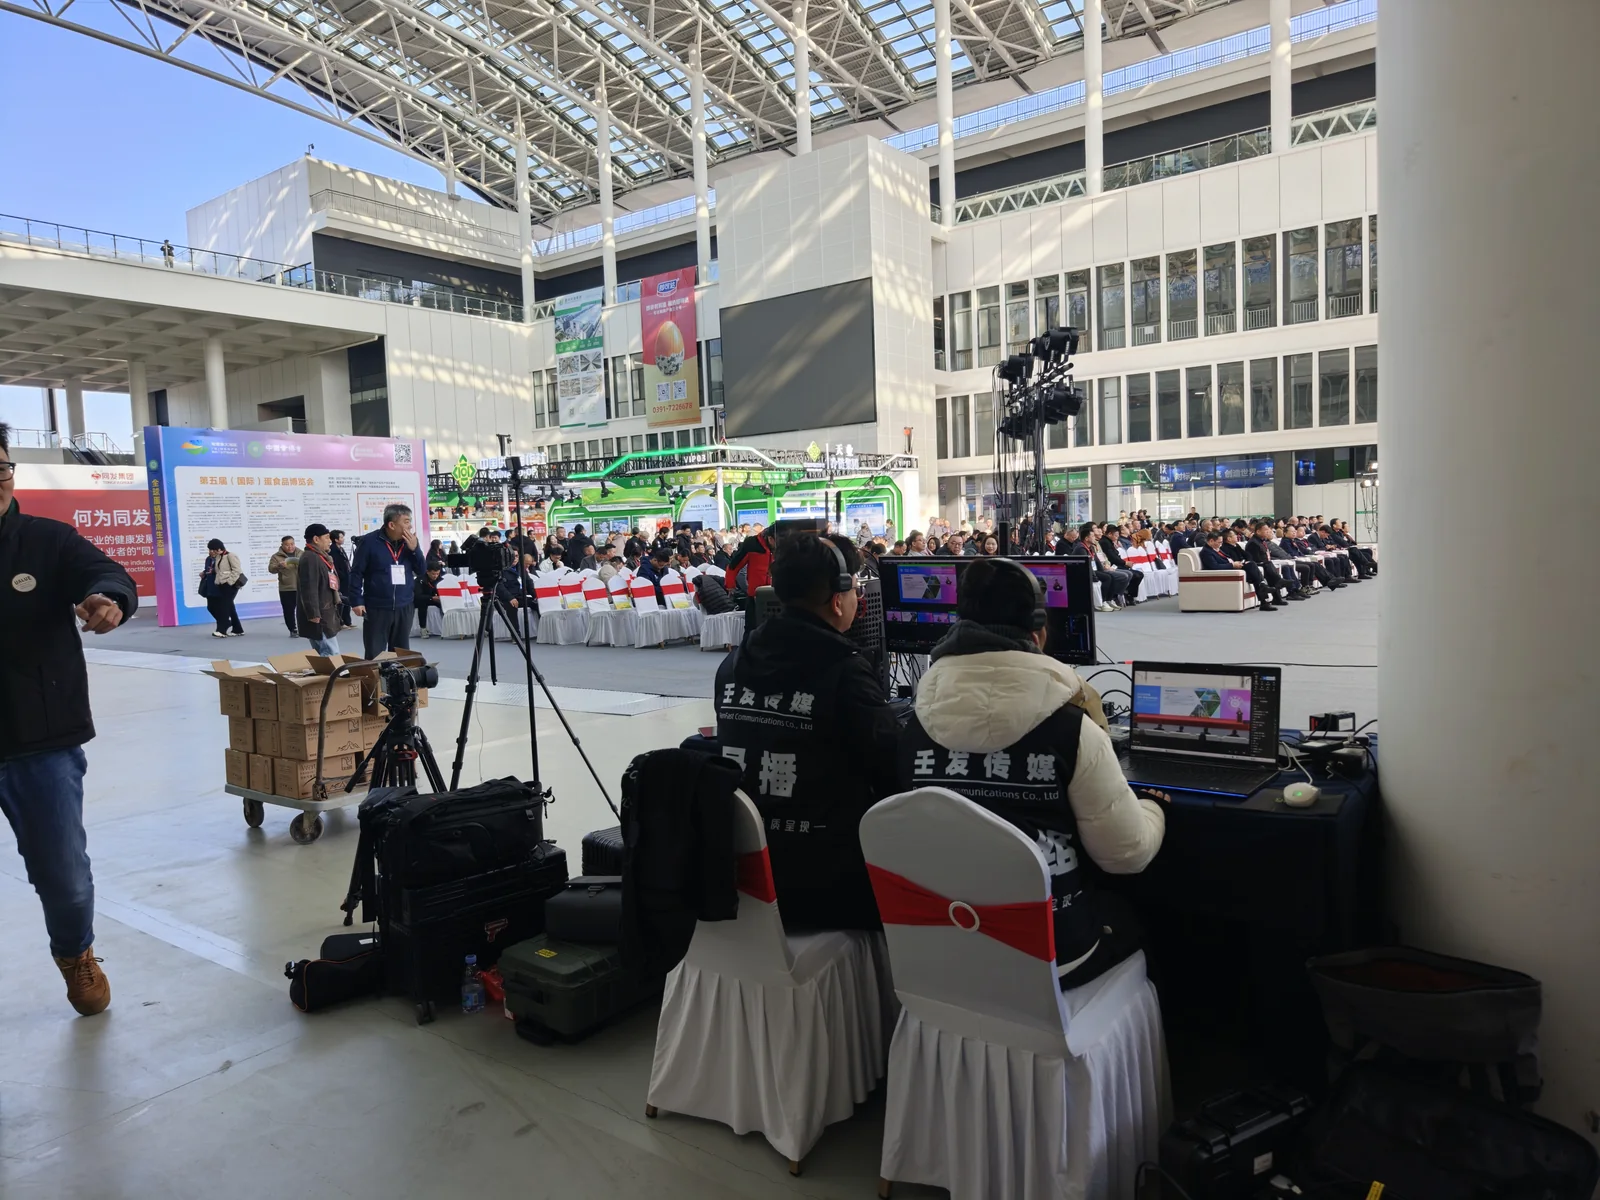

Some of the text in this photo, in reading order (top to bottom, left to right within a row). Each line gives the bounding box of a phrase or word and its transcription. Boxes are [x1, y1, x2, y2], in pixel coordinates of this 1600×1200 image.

[72, 509, 151, 528] 何为同发
[734, 712, 785, 727] Communications
[800, 722, 813, 730] Ltd
[1044, 791, 1059, 800] Ltd
